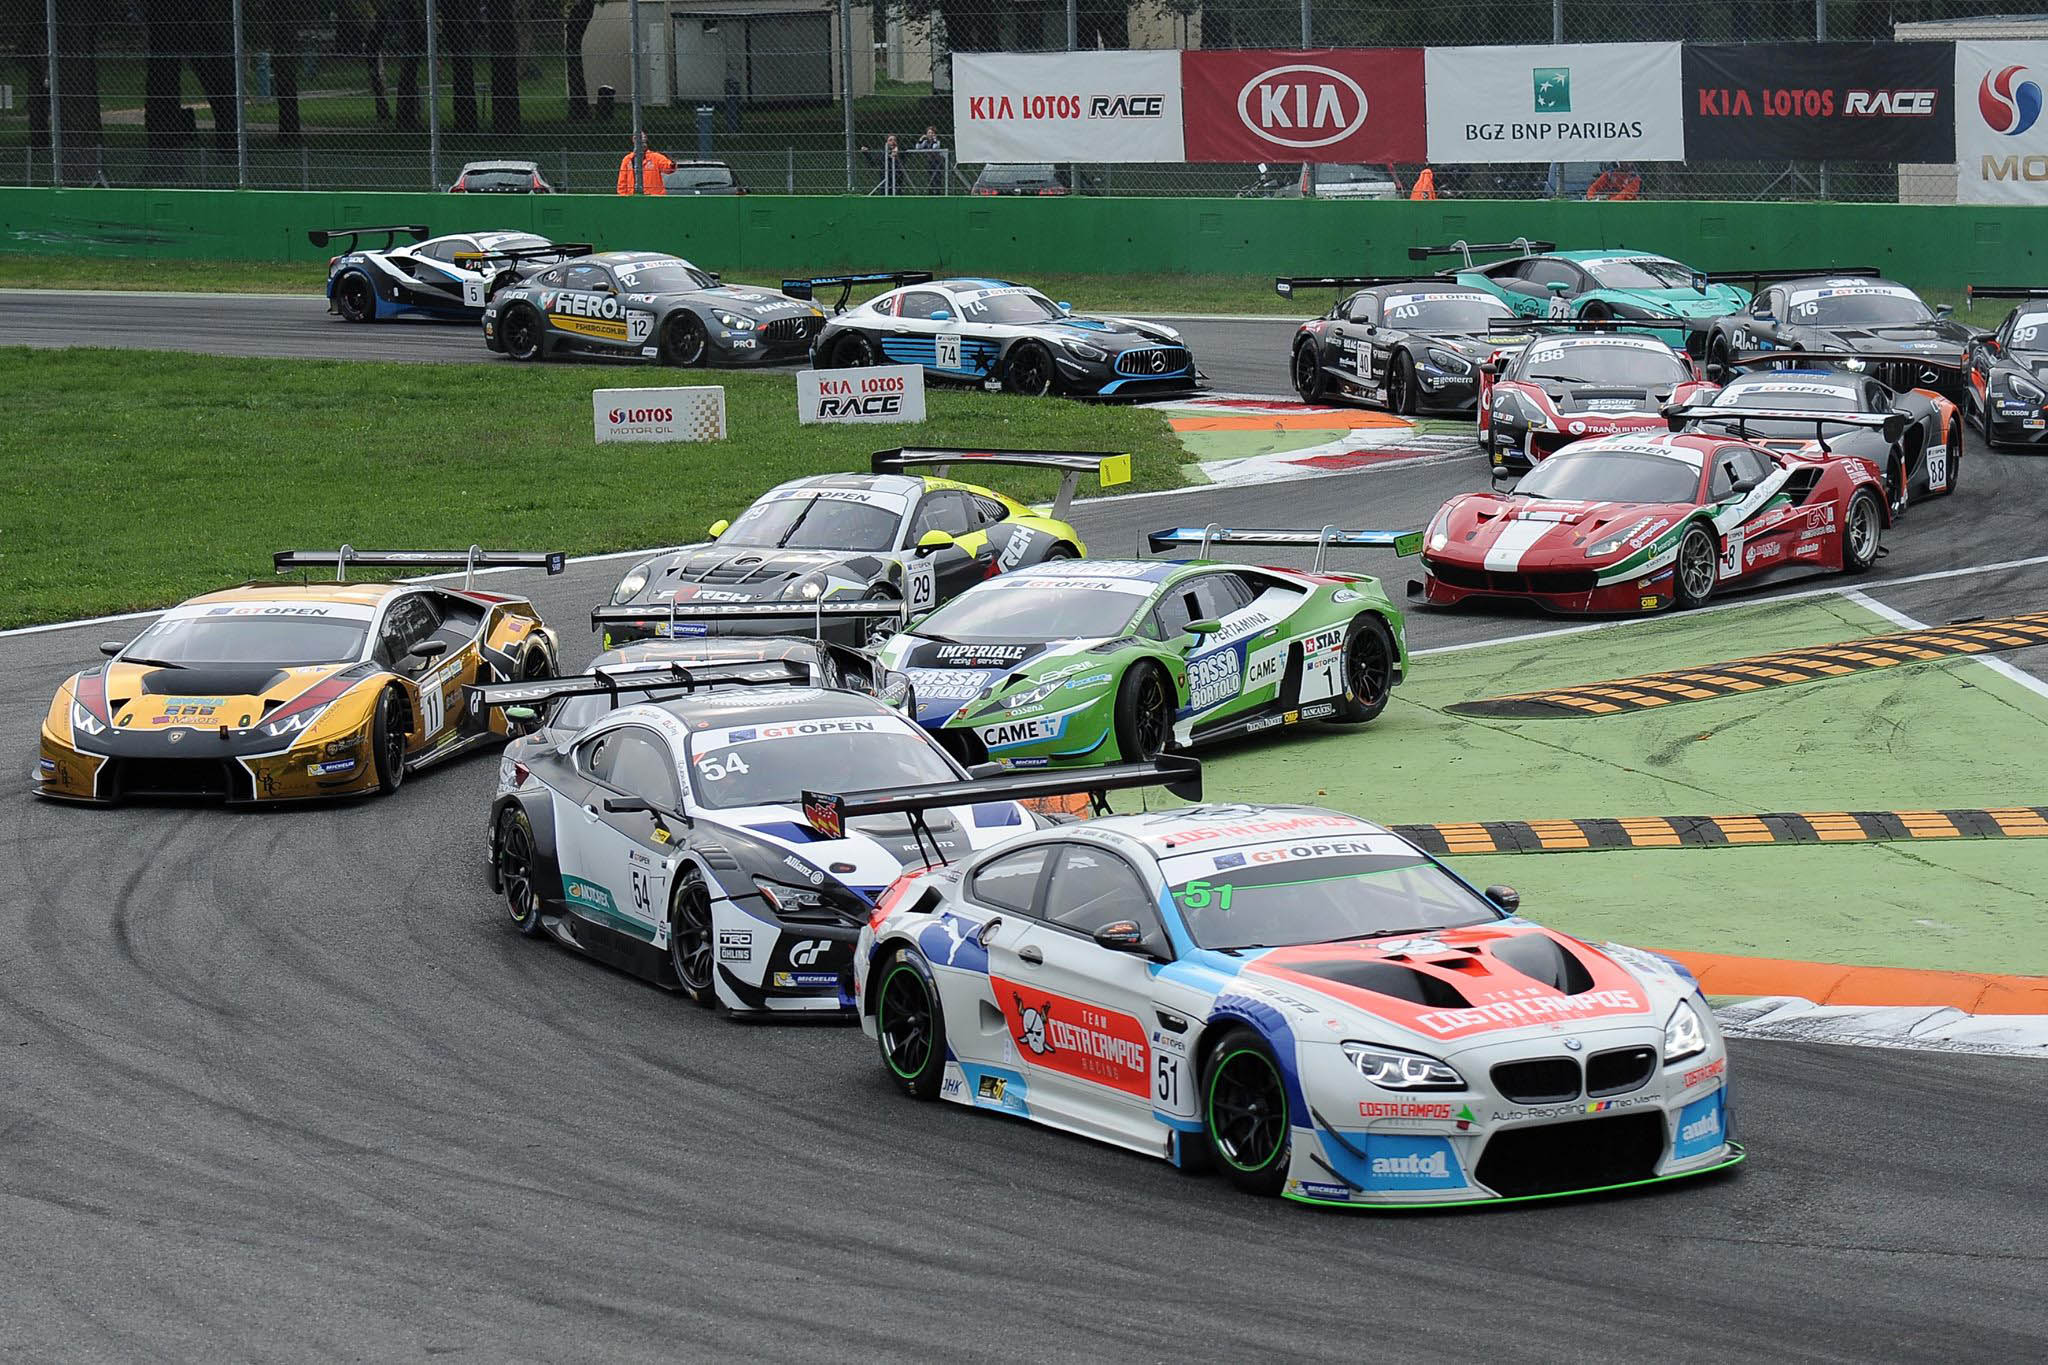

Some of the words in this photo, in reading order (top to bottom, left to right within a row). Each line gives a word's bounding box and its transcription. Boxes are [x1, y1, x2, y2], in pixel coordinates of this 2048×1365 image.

[970, 96, 1014, 119] KIA
[1022, 96, 1081, 119] LOTOS
[1089, 96, 1164, 117] RACE
[1259, 83, 1347, 129] KIA
[1699, 88, 1753, 117] KIA
[1763, 88, 1835, 117] LOTOS
[1844, 91, 1937, 114] RACE
[1511, 123, 1552, 140] BNP
[1557, 121, 1643, 139] PARIBAS
[620, 273, 641, 288] 12
[470, 286, 478, 302] 5
[961, 299, 989, 316] 74
[1395, 304, 1419, 319] 40
[1551, 305, 1565, 319] 21
[1795, 302, 1819, 317] 16
[631, 319, 648, 337] 12
[2012, 326, 2038, 343] 99
[939, 344, 957, 365] 74
[1359, 353, 1370, 373] 40
[1527, 348, 1566, 365] 488
[820, 378, 852, 395] KIA
[861, 376, 905, 392] LOTOS
[628, 407, 673, 423] LOTOS
[817, 394, 903, 418] RACE
[610, 427, 652, 435] MOTOR
[654, 426, 673, 434] OIL
[1930, 459, 1945, 484] 88
[1727, 544, 1735, 570] 8
[912, 574, 931, 604] 29
[1209, 610, 1271, 643] PERTAMINA
[1315, 630, 1342, 650] STAR
[936, 644, 1027, 660] IMPERIALE
[949, 657, 971, 667] racing
[1249, 657, 1277, 682] CAME
[1322, 665, 1334, 696] 1
[1190, 672, 1241, 711] BORTOLO
[426, 690, 440, 732] 11
[1283, 711, 1299, 723] OMP
[983, 721, 1039, 746] CAME
[325, 760, 355, 771] MICHELIN
[698, 750, 750, 782] 54
[1014, 757, 1048, 767] MICHELIN
[784, 854, 813, 877] Allianz
[580, 883, 610, 909] MOTOREX
[631, 871, 652, 913] 54
[1183, 880, 1235, 911] 51
[796, 975, 839, 984] MICHELIN
[1485, 987, 1541, 1000] TEAM
[1082, 1009, 1108, 1030] TEAM
[1415, 1000, 1523, 1034] COSTA
[1521, 990, 1640, 1017] CAMPOS
[1048, 1018, 1092, 1055] COSTA
[1090, 1030, 1146, 1073] CAMPOS
[942, 1077, 963, 1094] JHK
[1157, 1055, 1179, 1108] 51
[1359, 1101, 1399, 1118] COSTA
[1400, 1102, 1452, 1119] CAMPOS
[1489, 1101, 1587, 1122] Auto-Recycling
[1306, 1184, 1350, 1197] MICHELIN
